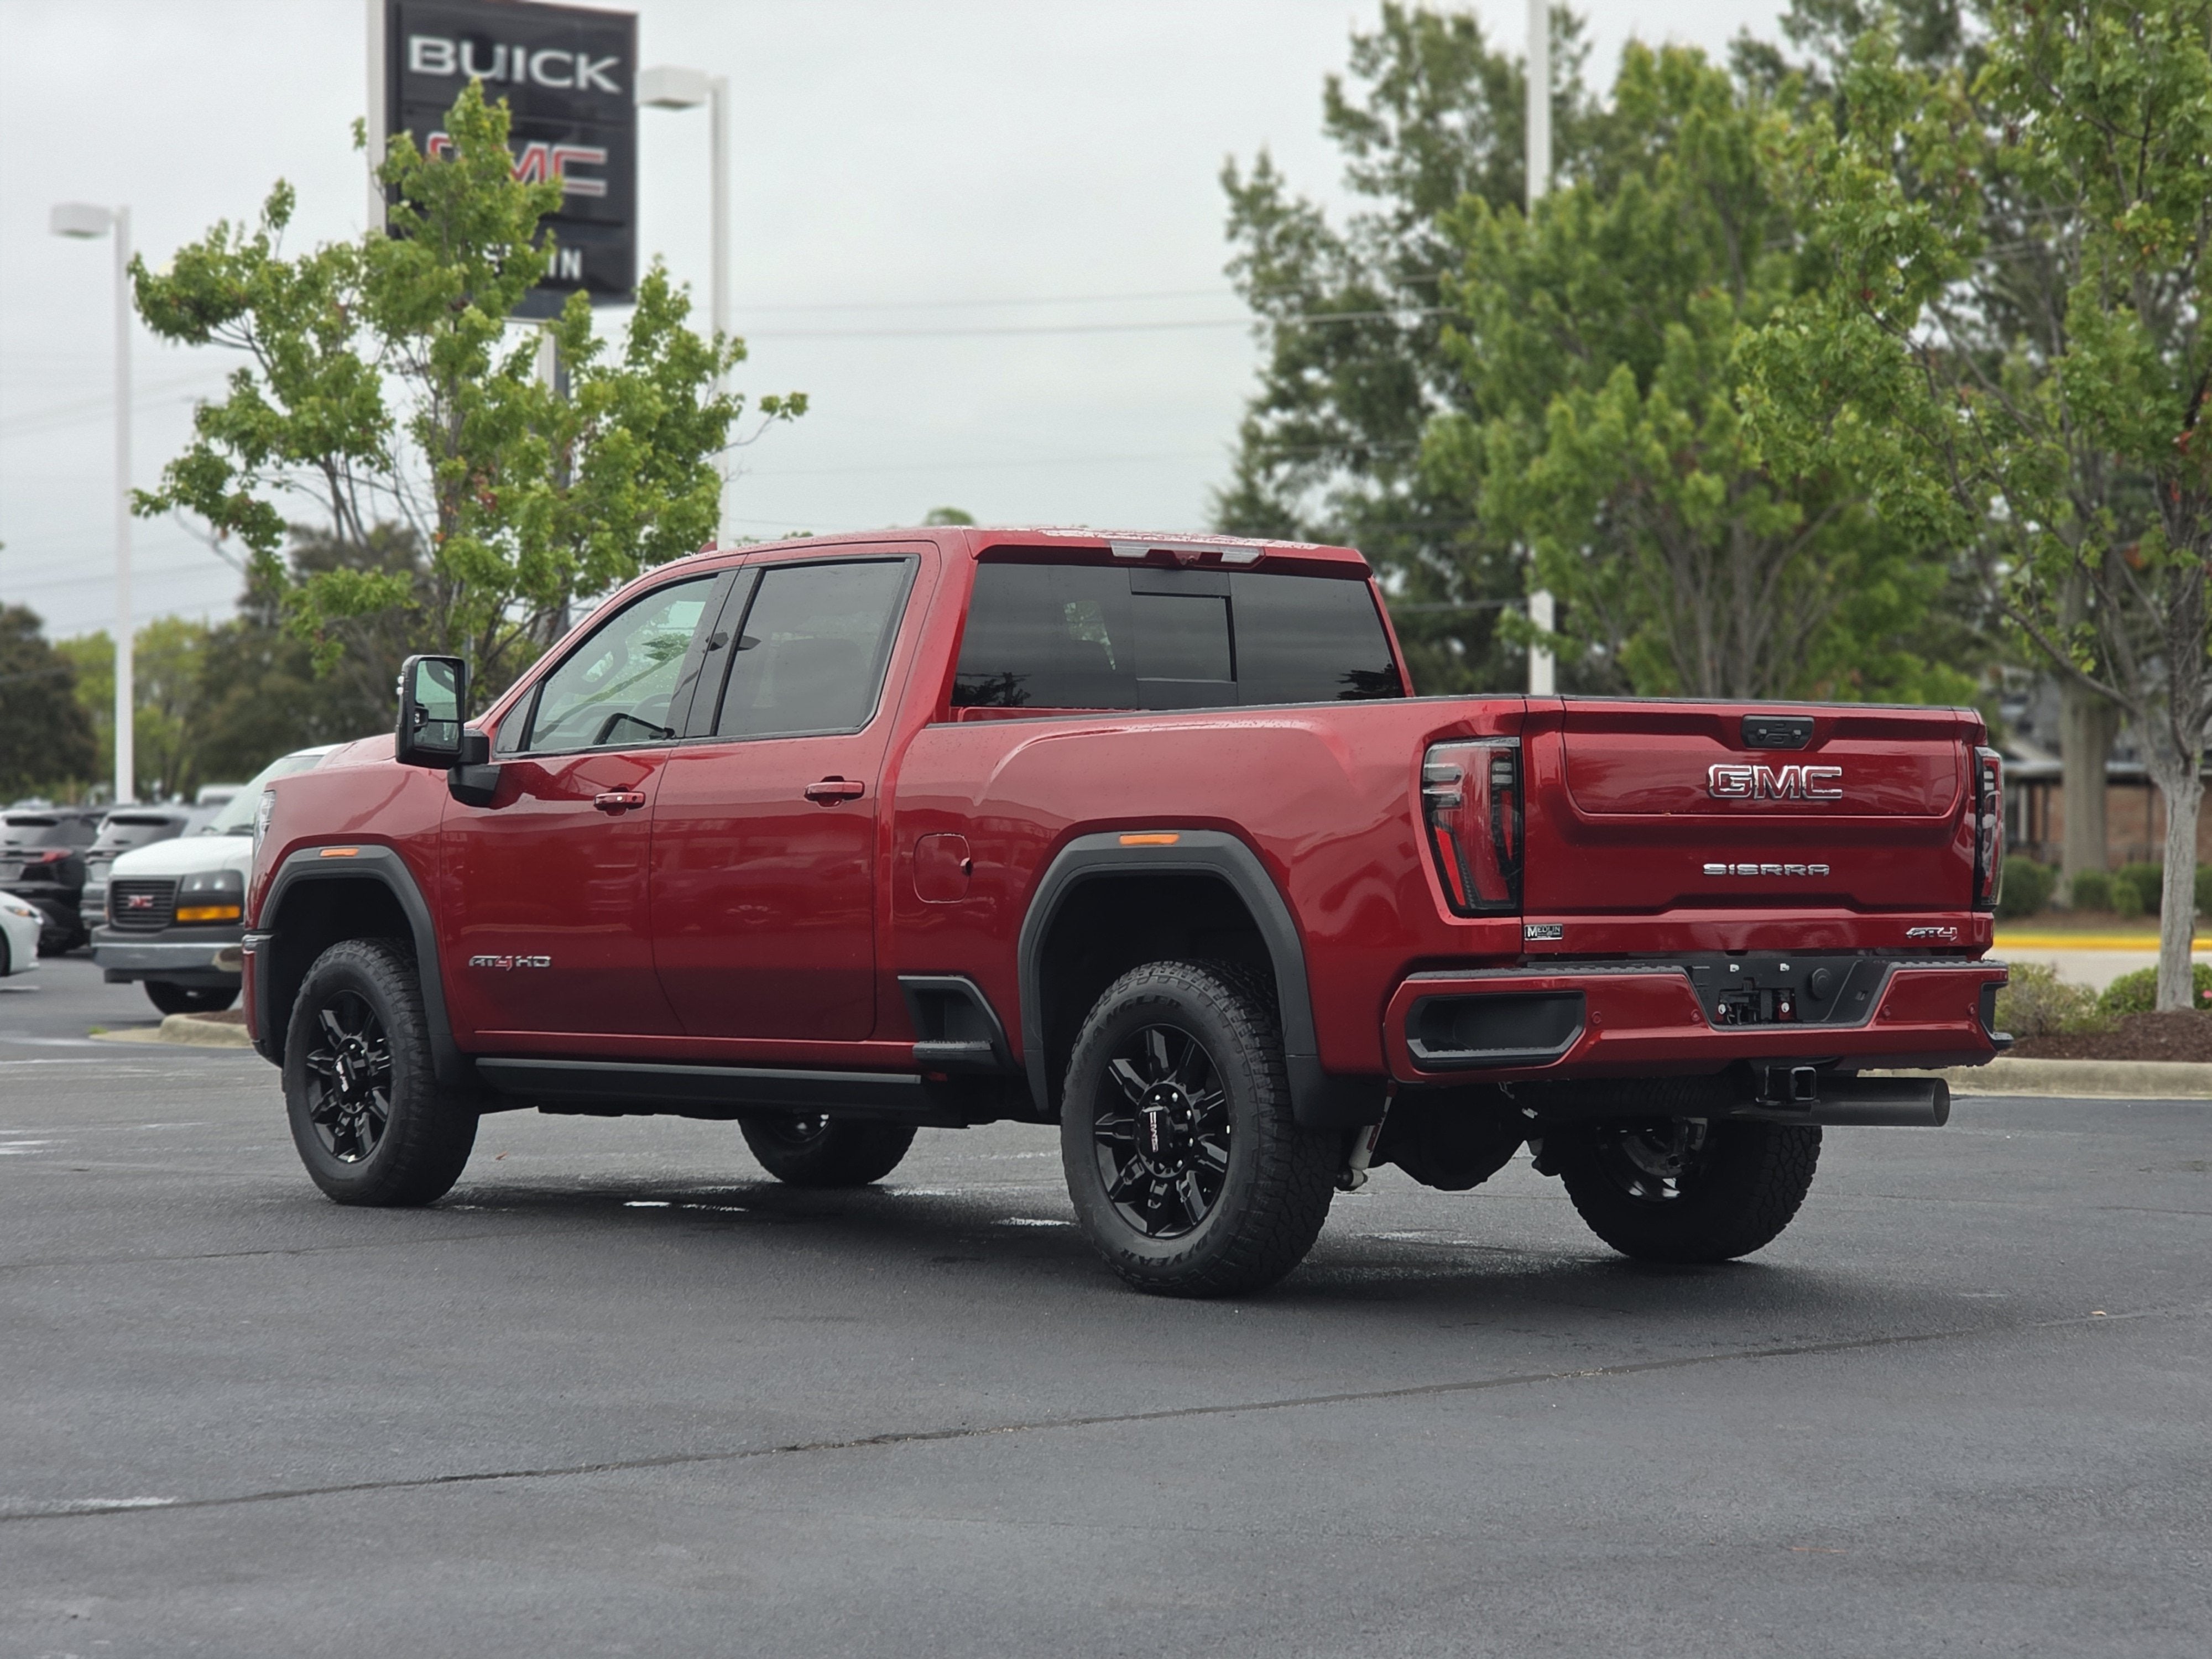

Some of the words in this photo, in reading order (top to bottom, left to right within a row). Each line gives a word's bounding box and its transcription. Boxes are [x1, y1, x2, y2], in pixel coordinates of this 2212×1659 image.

[408, 35, 622, 93] BUICK
[426, 131, 607, 197] MC
[1708, 764, 1843, 799] GMC
[1703, 863, 1830, 876] SIERRA
[1906, 927, 1958, 941] AT4
[469, 955, 513, 972] AT4
[515, 955, 551, 967] HD
